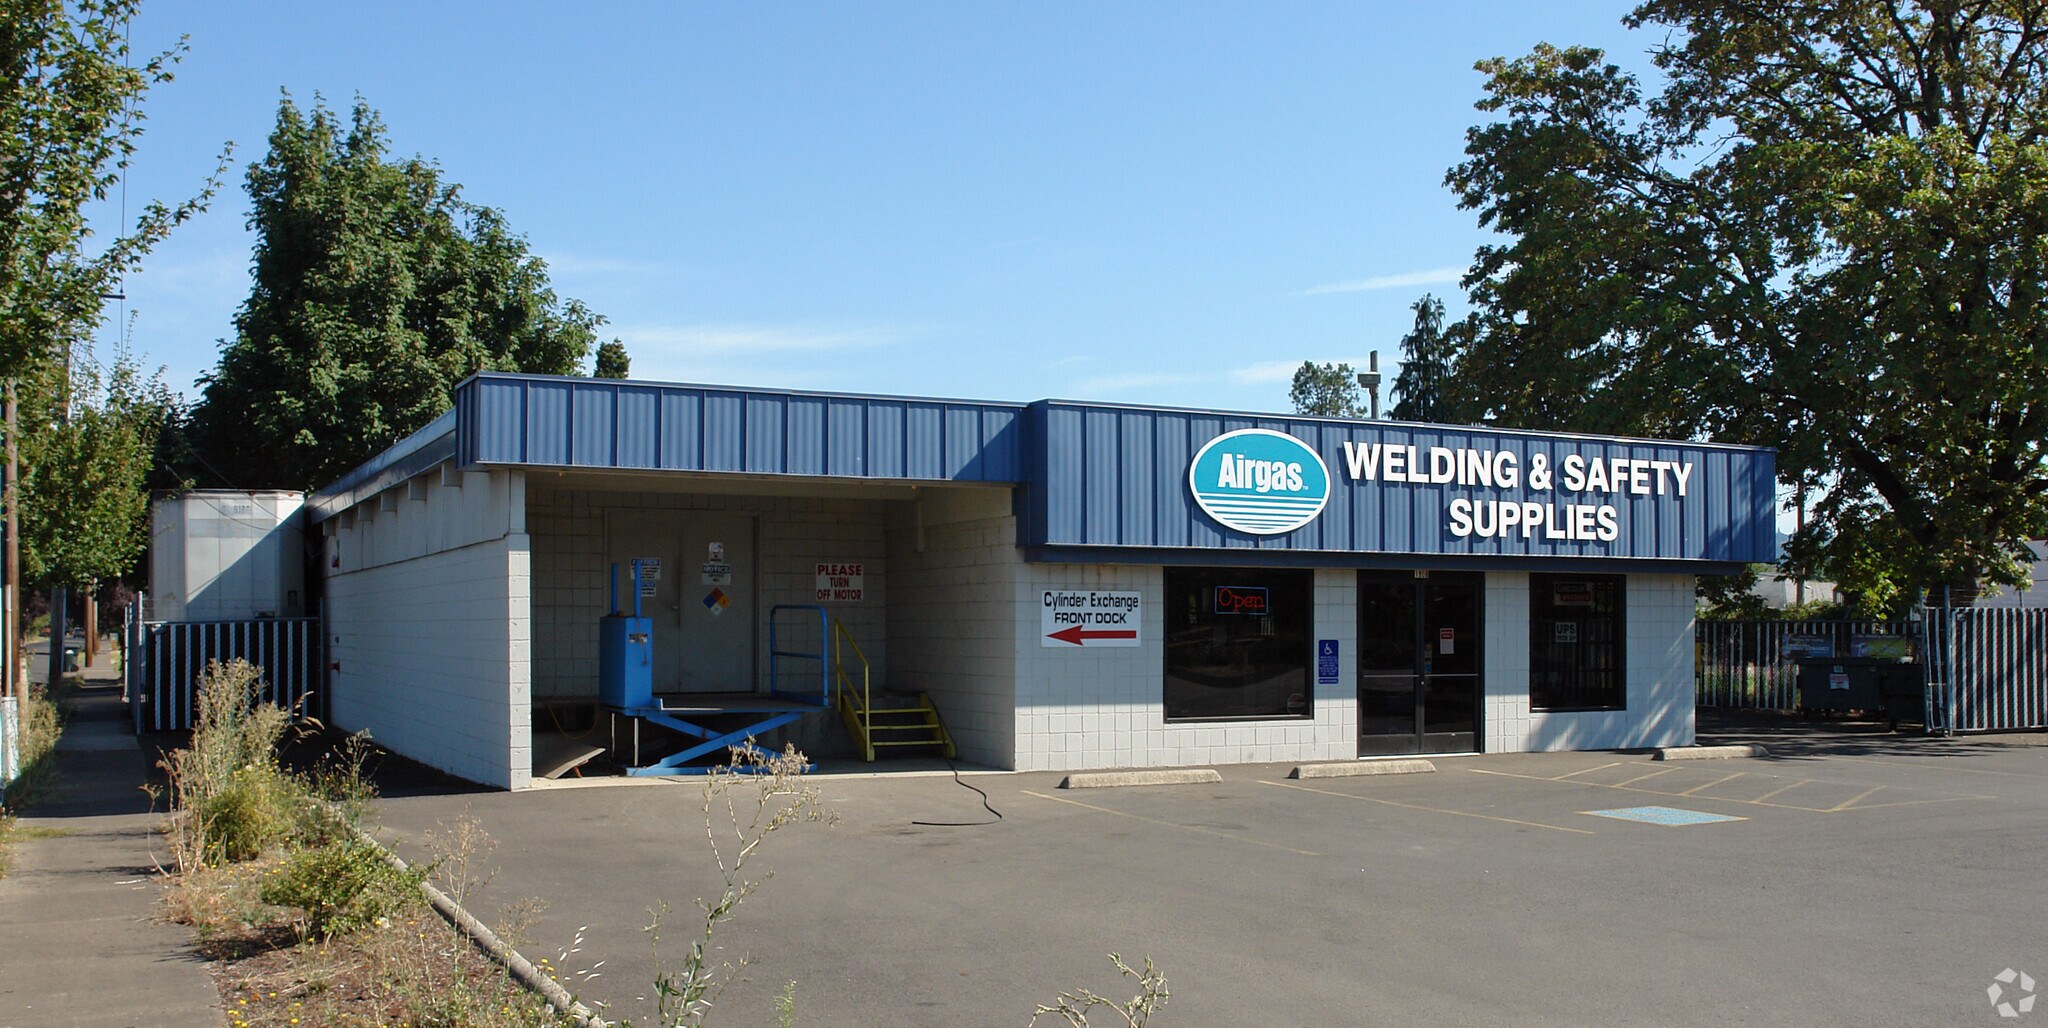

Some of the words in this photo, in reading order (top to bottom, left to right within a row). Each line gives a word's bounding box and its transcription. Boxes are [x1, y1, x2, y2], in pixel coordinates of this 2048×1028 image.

[1217, 453, 1303, 493] Airgas
[1343, 441, 1518, 488] WELDING
[1529, 453, 1553, 490] &
[1564, 454, 1693, 496] SAFETY
[1450, 498, 1619, 542] SUPPLIES
[818, 565, 862, 576] PLEASE
[829, 577, 850, 588] TURN
[817, 589, 831, 600] OFF
[834, 589, 862, 601] MOTOR
[1044, 592, 1087, 611] Cylinder
[1090, 592, 1139, 612] Exchange
[1218, 588, 1265, 612] Open
[1055, 613, 1093, 624] FRONT
[1095, 613, 1127, 624] DOCK
[1556, 624, 1576, 634] UPS
